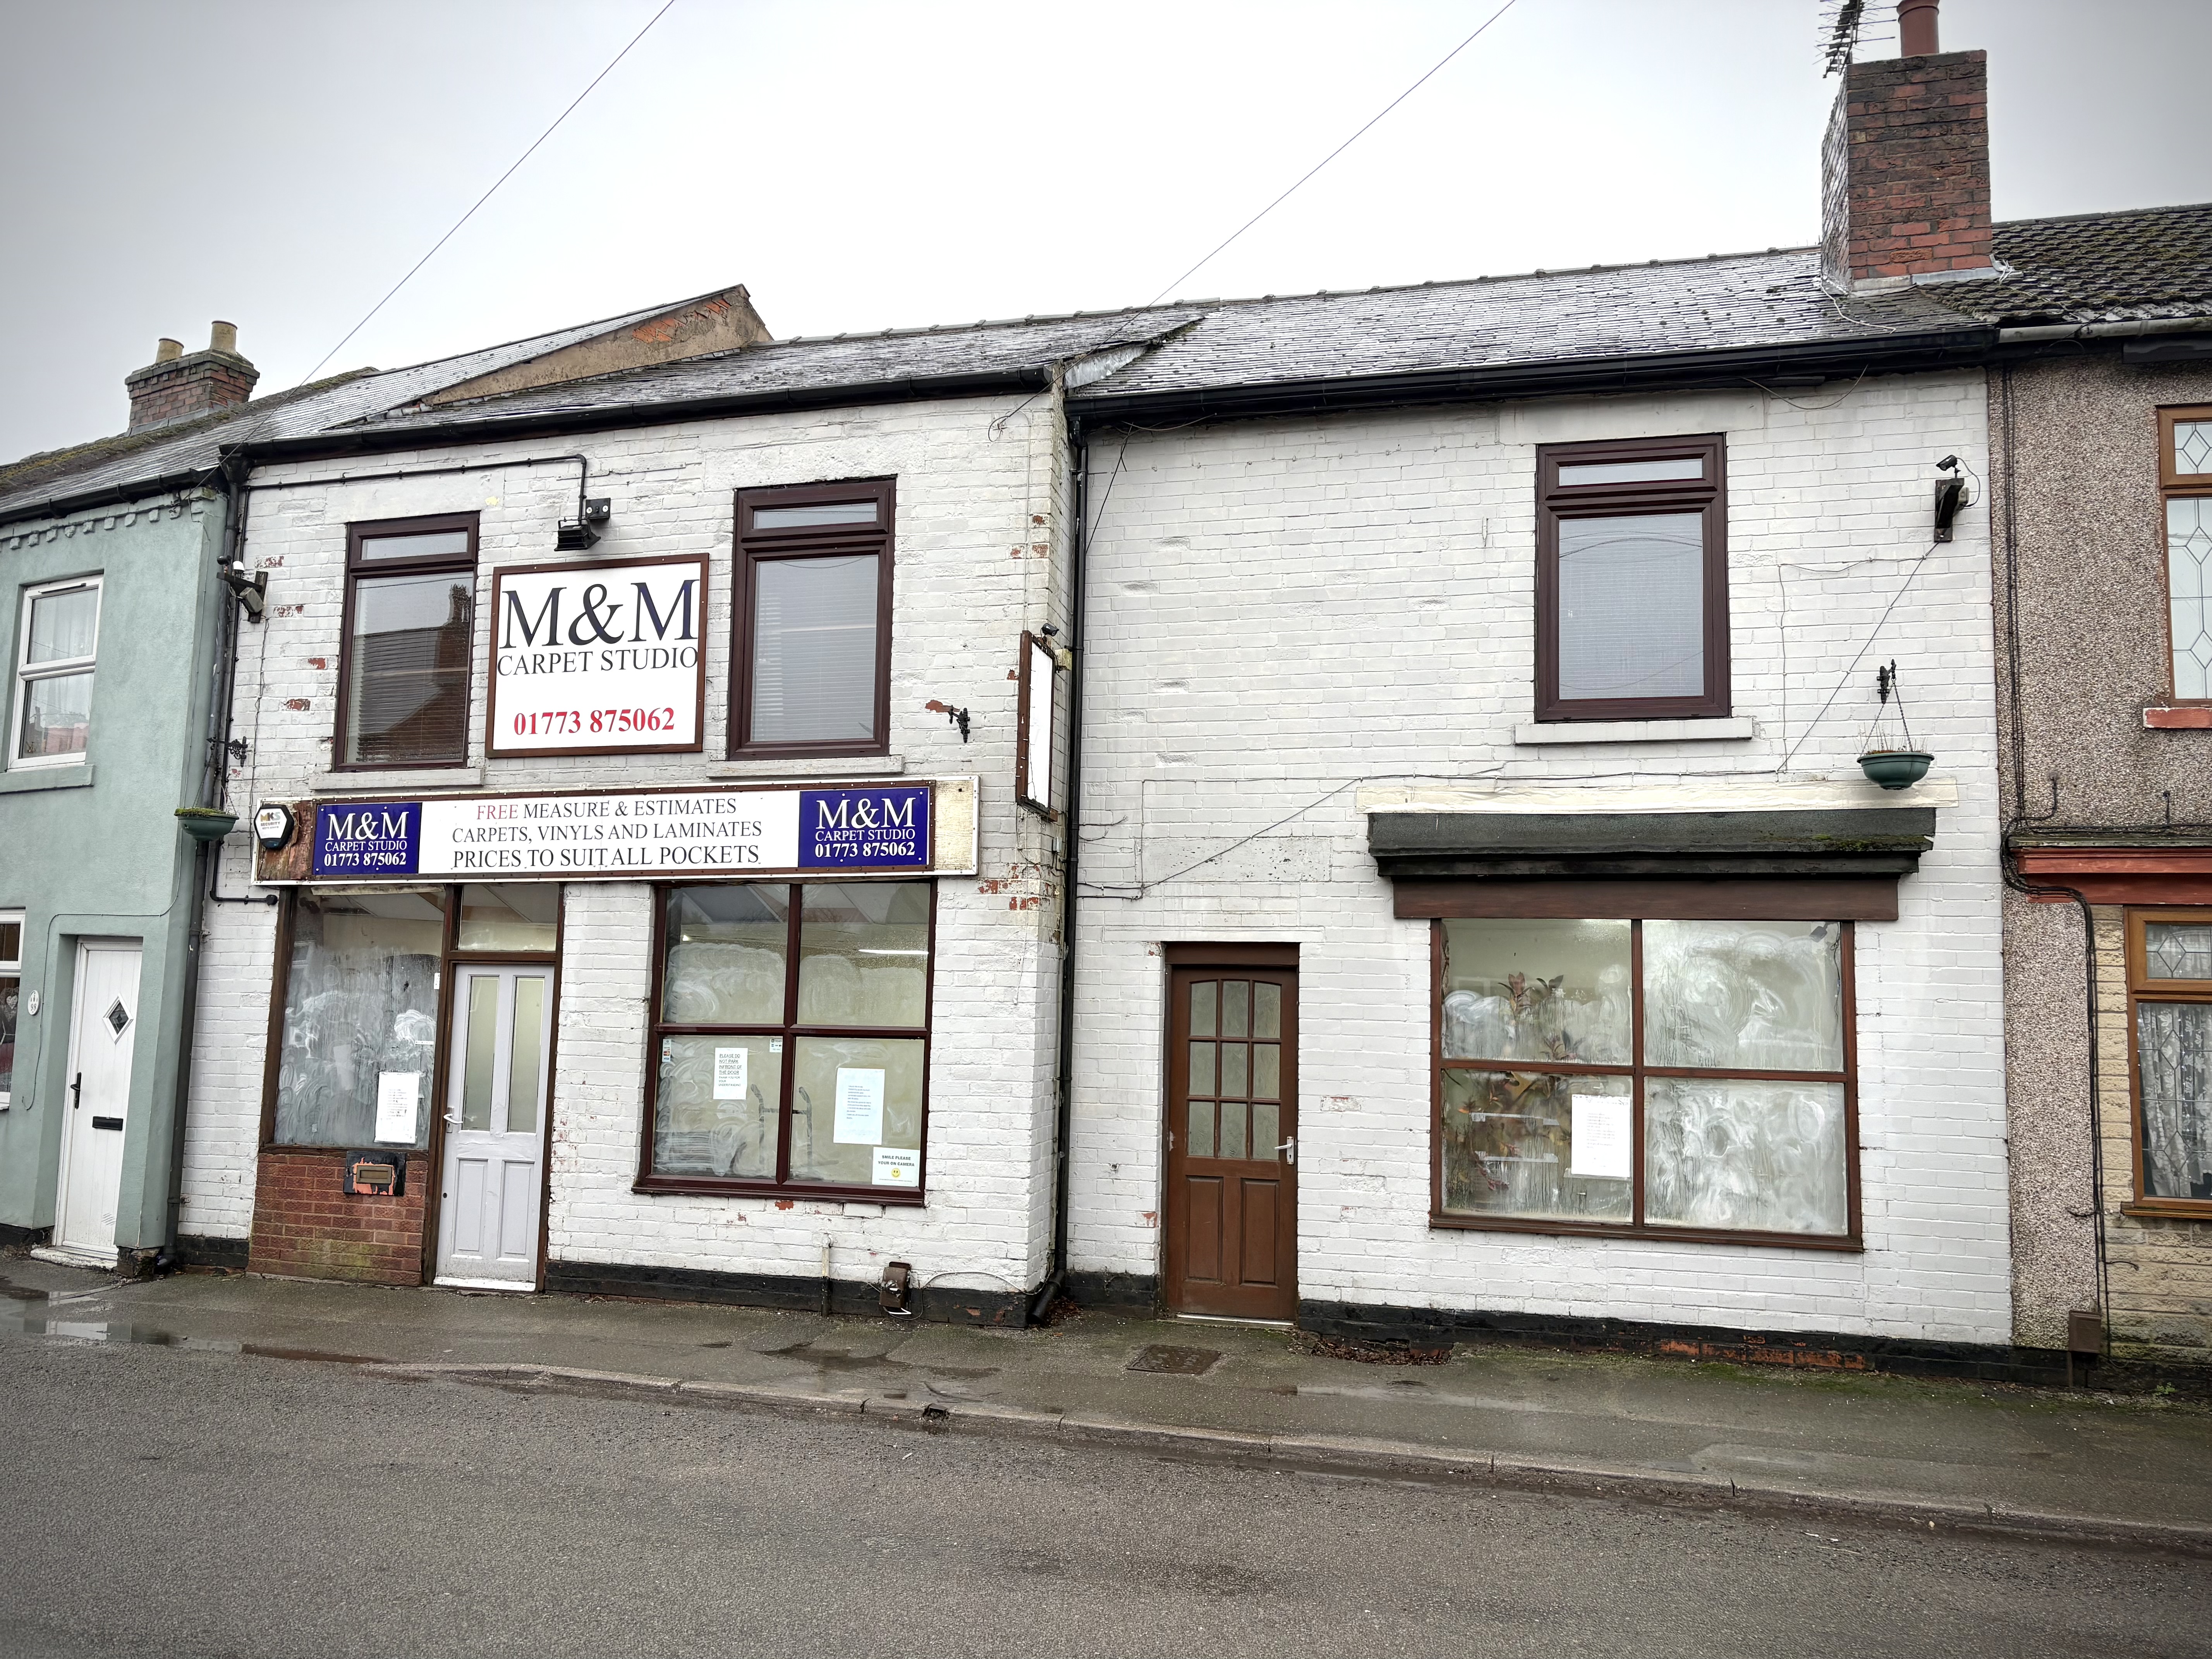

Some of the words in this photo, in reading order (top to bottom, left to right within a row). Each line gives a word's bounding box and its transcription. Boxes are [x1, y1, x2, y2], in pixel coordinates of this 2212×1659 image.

[499, 579, 700, 649] M&M
[497, 651, 593, 676] CARPET
[601, 647, 697, 671] STUDIO
[514, 711, 580, 735] 01773
[590, 708, 674, 732] 875062
[260, 812, 281, 822] MKS
[477, 804, 518, 819] FREE
[523, 802, 610, 819] MEASURE
[615, 801, 628, 816] &
[634, 798, 736, 816] ESTIMATES
[816, 797, 916, 829] M&M
[326, 812, 409, 840] M&M
[452, 826, 532, 844] CARPETS,
[538, 825, 603, 841] VINYLS
[608, 824, 647, 840] AND
[653, 821, 762, 838] LAMINATES
[815, 830, 864, 841] CARPET
[868, 829, 915, 840] STUDIO
[325, 841, 366, 852] CARPET
[368, 840, 407, 851] STUDIO
[453, 850, 521, 868] PRICES
[527, 849, 554, 867] TO
[561, 848, 608, 866] SUIT
[610, 848, 653, 866] ALL
[659, 845, 759, 864] POCKETS
[815, 843, 858, 857] 01773
[863, 842, 915, 857] 875062
[324, 853, 359, 866] 01773
[363, 852, 406, 866] 875062
